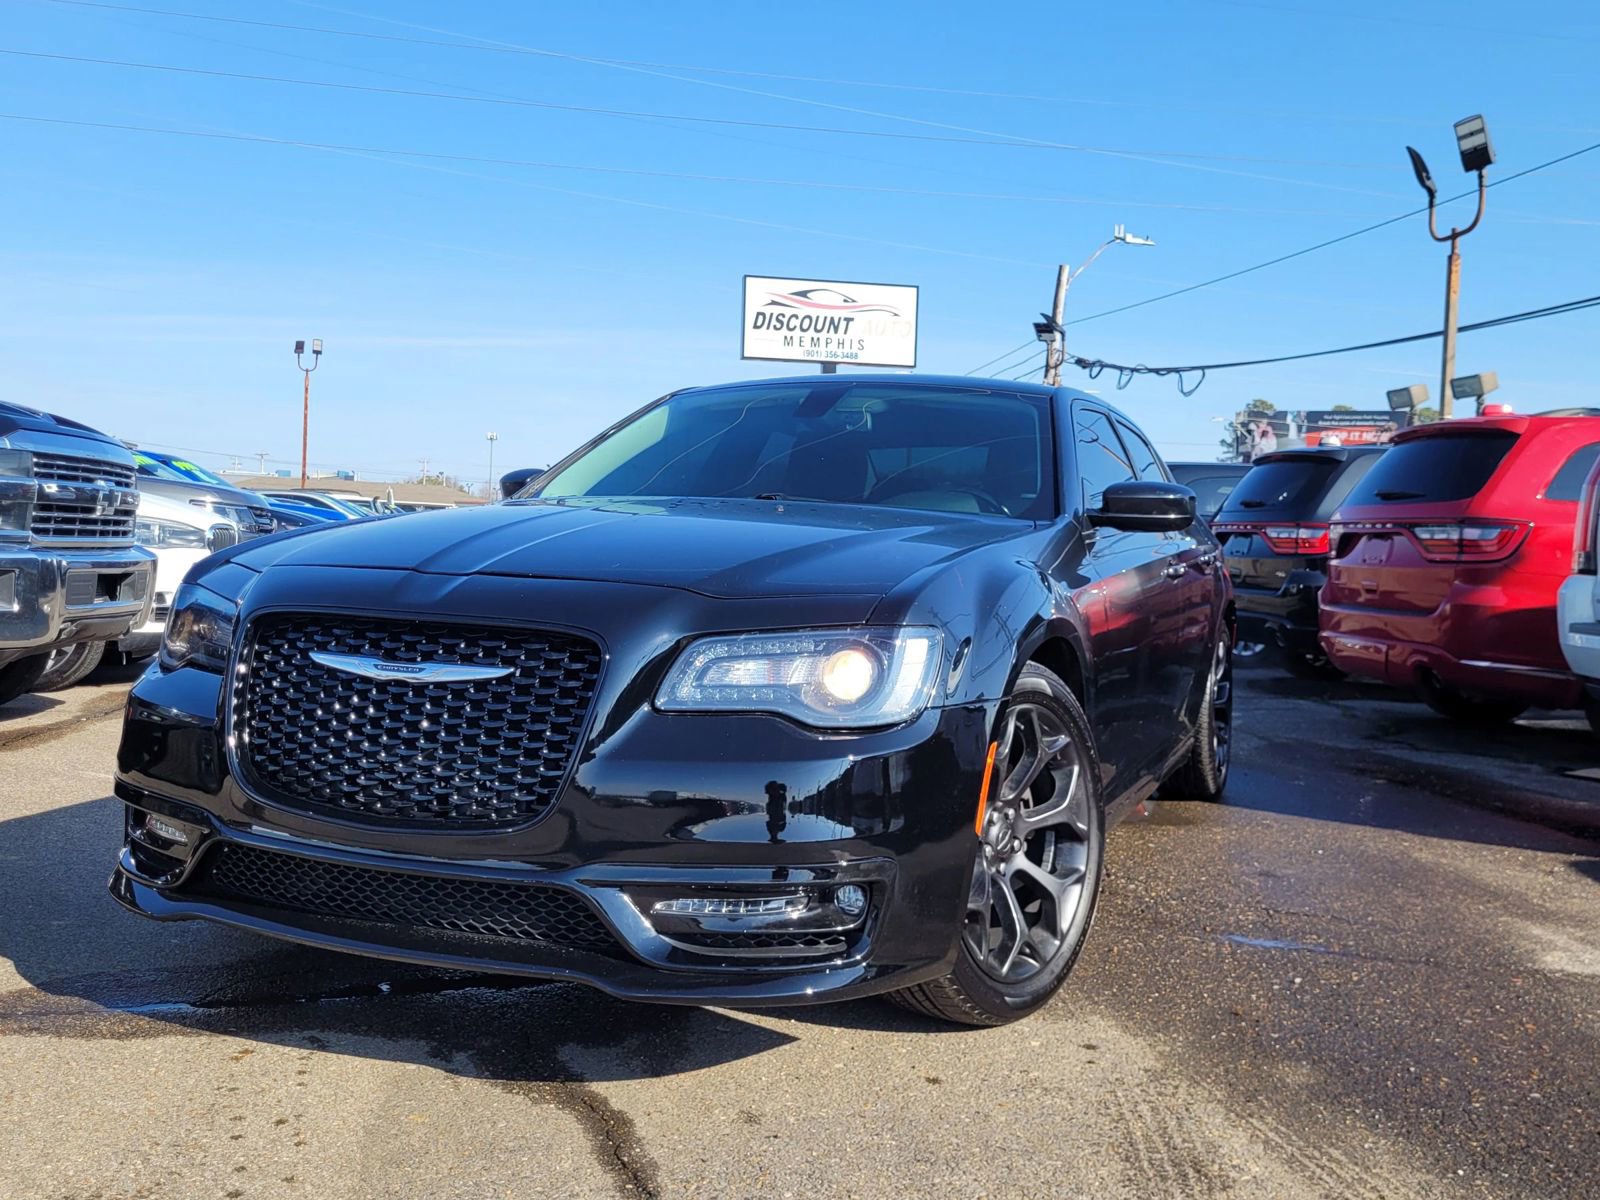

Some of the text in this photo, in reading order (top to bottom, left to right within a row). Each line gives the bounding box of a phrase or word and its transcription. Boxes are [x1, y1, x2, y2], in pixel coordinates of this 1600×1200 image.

[752, 311, 855, 335] DISCOUNT
[783, 335, 865, 350] MEMPHIS
[803, 350, 858, 360] (901) 356-3488
